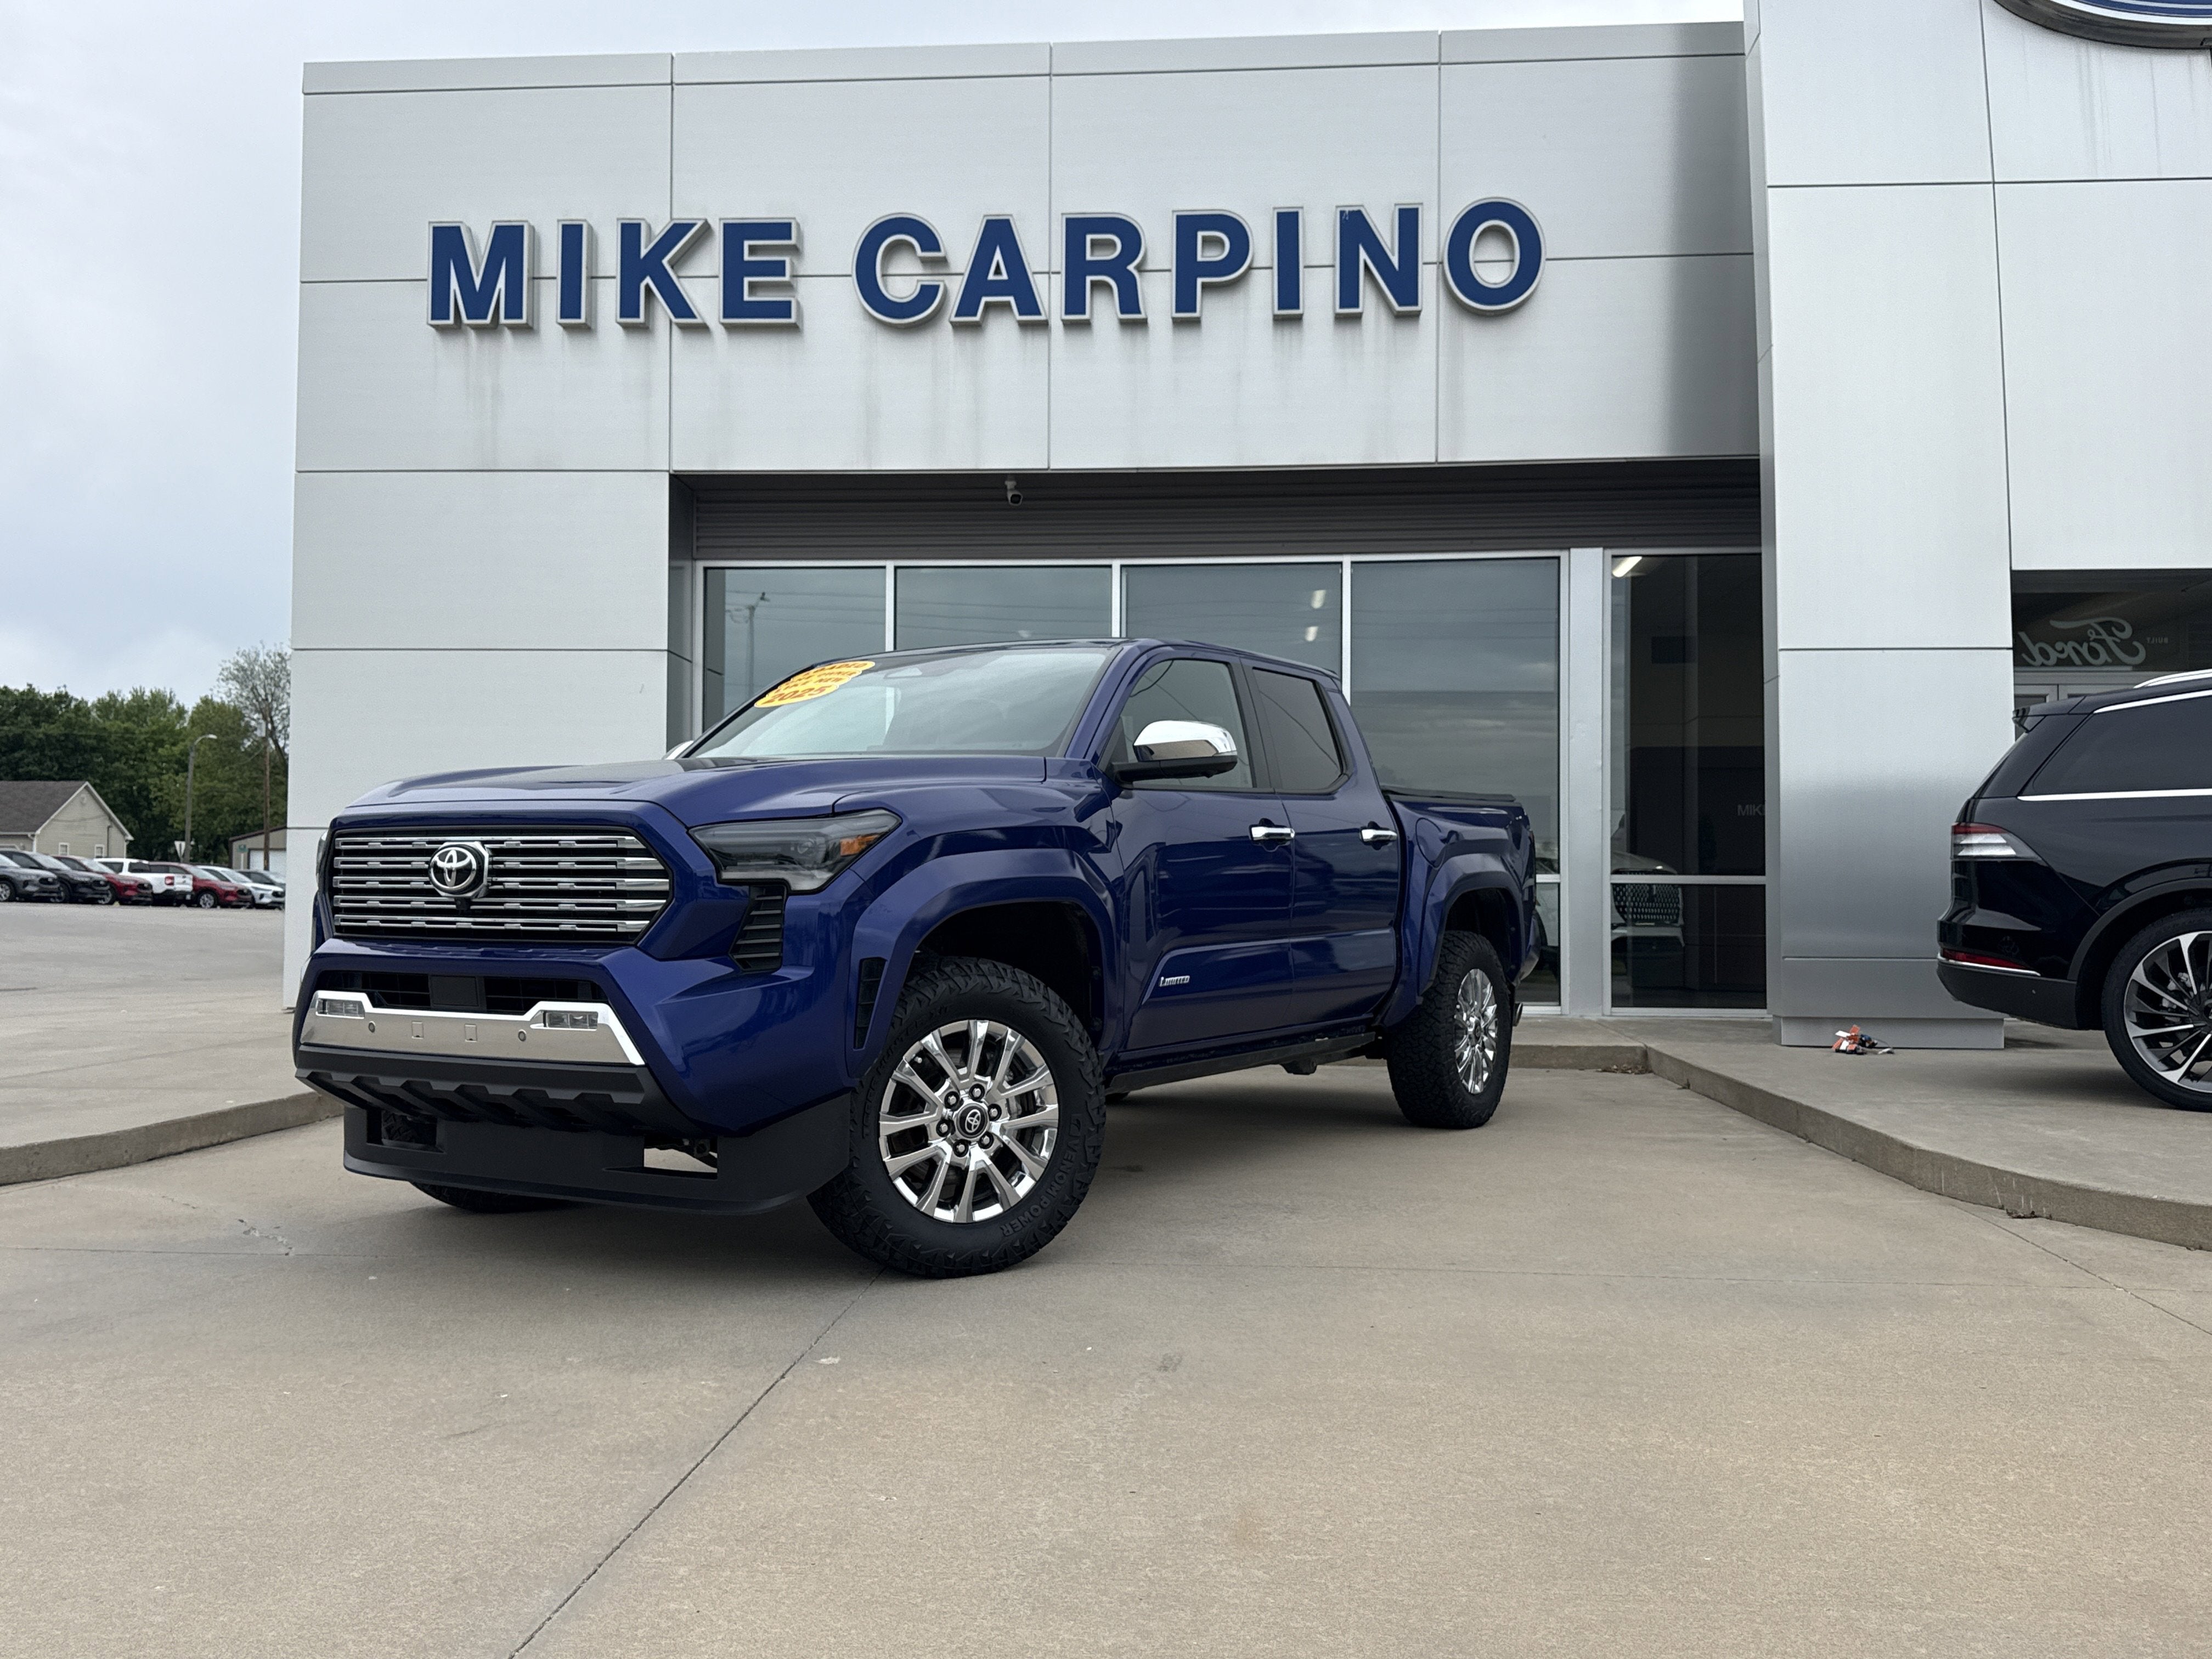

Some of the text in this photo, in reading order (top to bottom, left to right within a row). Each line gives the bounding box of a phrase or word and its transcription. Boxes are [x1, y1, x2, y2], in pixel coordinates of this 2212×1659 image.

[427, 197, 1546, 329] MIKE CARPINO
[761, 685, 833, 705] 2025
[1737, 804, 1765, 816] MIK
[1000, 1138, 1081, 1237] VENOM POWER
